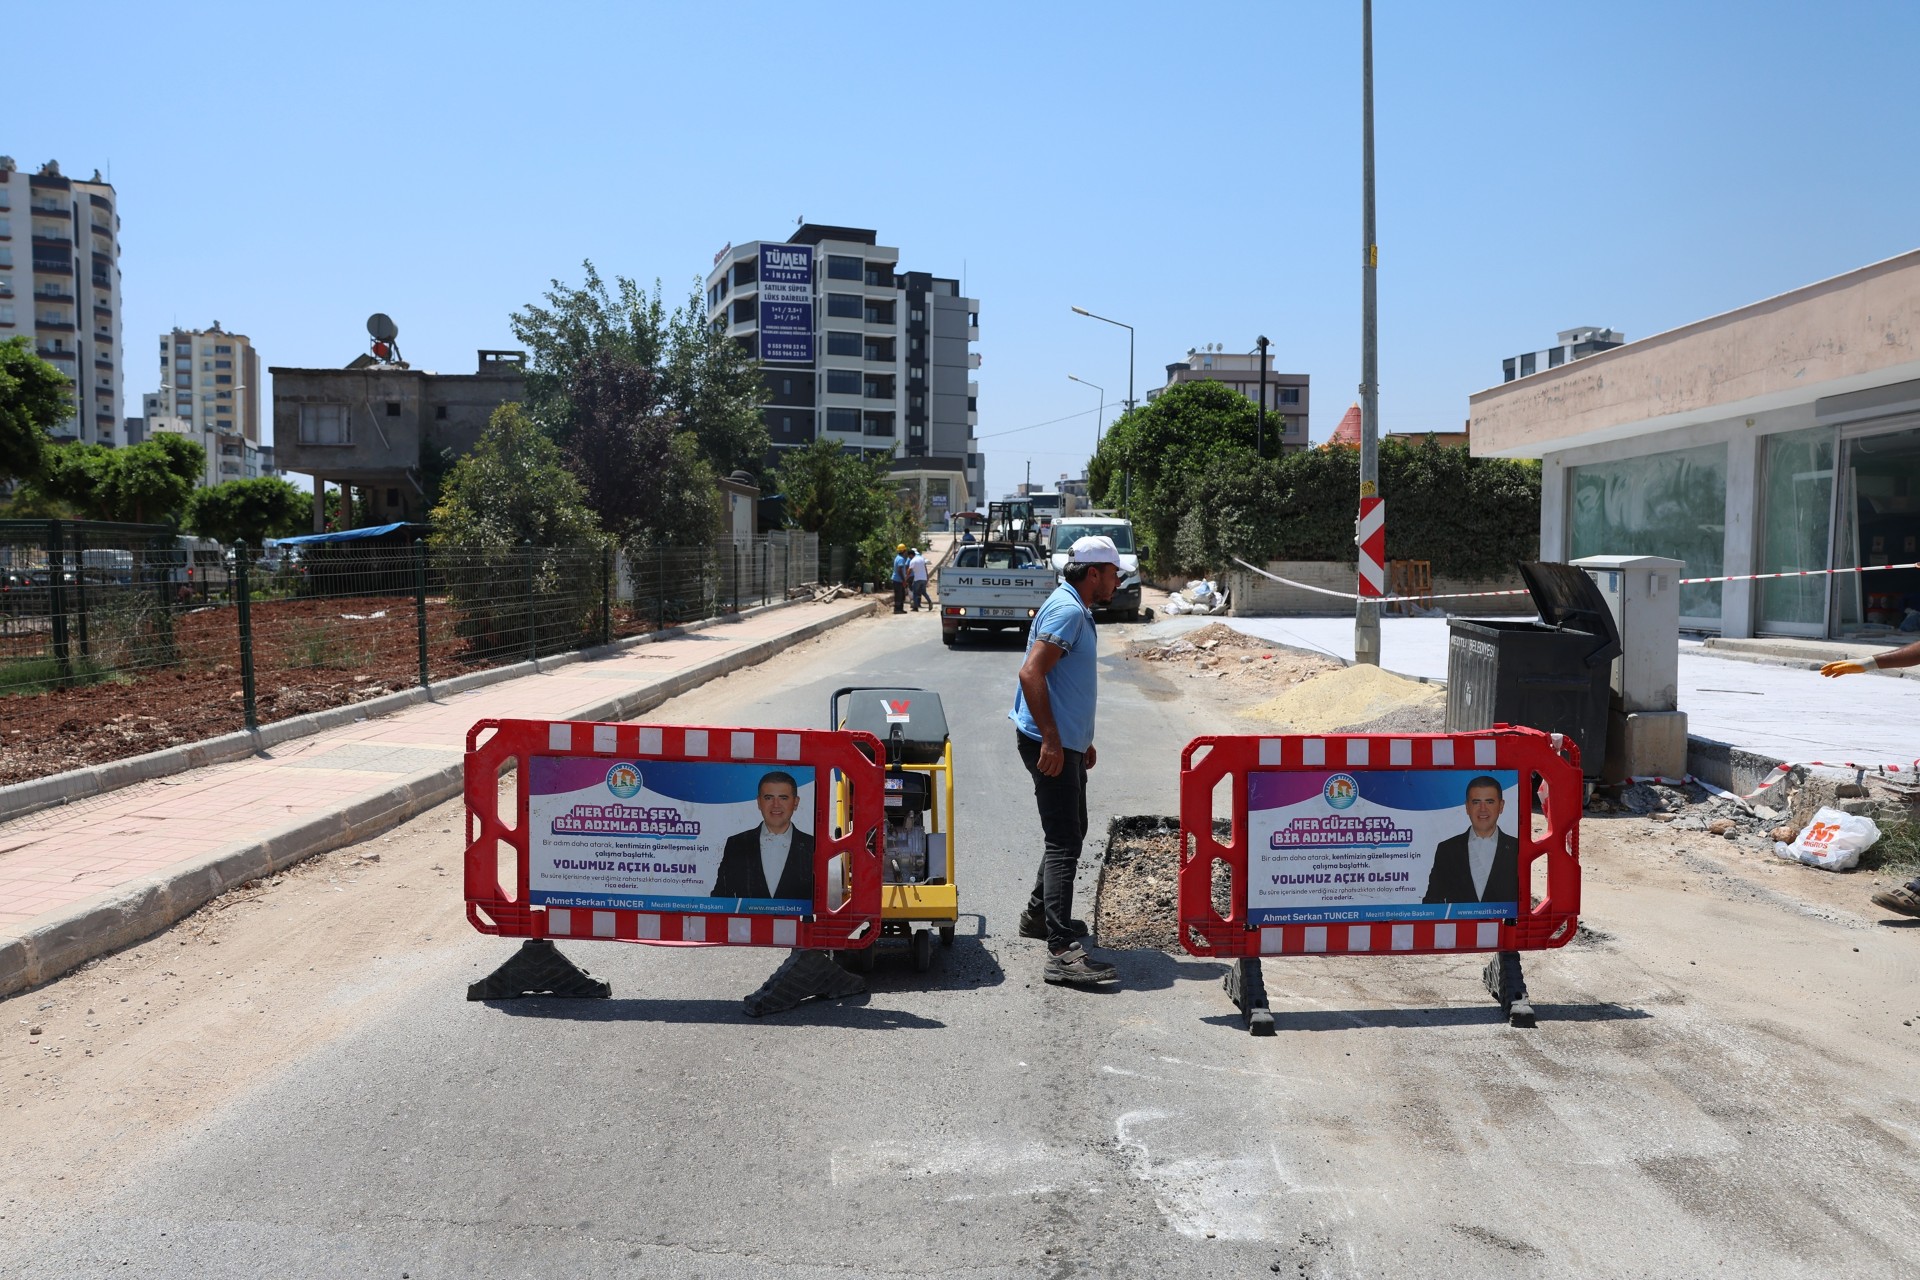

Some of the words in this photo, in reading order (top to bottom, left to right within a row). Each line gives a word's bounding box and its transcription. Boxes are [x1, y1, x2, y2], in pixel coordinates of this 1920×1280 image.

[765, 249, 807, 270] TÜMEN
[772, 270, 801, 280] İNŞAAT
[764, 284, 787, 292] SATILIK
[788, 284, 807, 293] SÜPER
[764, 293, 780, 301] LÜKS
[780, 294, 809, 302] DAİRELER
[959, 577, 973, 585] MI
[575, 806, 602, 818] HER
[604, 805, 648, 819] GÜZEL
[650, 808, 679, 822] ŞEY,
[556, 817, 582, 830] BİR
[584, 819, 638, 832] ADIMLA
[640, 821, 699, 834] BAŞLAR!
[1294, 819, 1320, 831] HER
[1322, 817, 1363, 830] GÜZEL
[1365, 818, 1393, 832] ŞEY,
[1275, 830, 1300, 844] BİR
[1302, 832, 1354, 843] ADIMLA
[1356, 830, 1412, 844] BAŞLAR!
[615, 841, 651, 850] kentimizin
[652, 843, 696, 852] güzelleşmesi
[697, 844, 709, 852] için
[1803, 841, 1828, 850] MIGROS
[595, 850, 622, 858] çalışma
[623, 851, 656, 859] başlattık.
[1367, 852, 1408, 860] güzelleşmesi
[1409, 852, 1421, 860] için
[553, 859, 615, 871] YOLUMUZ
[617, 861, 650, 873] AÇIK
[653, 863, 697, 874] OLSUN
[1339, 861, 1371, 870] başlattık.
[1271, 873, 1332, 885] YOLUMUZ
[1334, 873, 1365, 884] AÇIK
[1368, 872, 1409, 882] OLSUN
[545, 896, 574, 905] Ahmet
[575, 898, 606, 907] Serkan
[607, 899, 644, 908] TUNCER
[1263, 913, 1292, 922] Ahmet
[1292, 912, 1322, 921] Serkan
[1323, 911, 1360, 920] TUNCER
